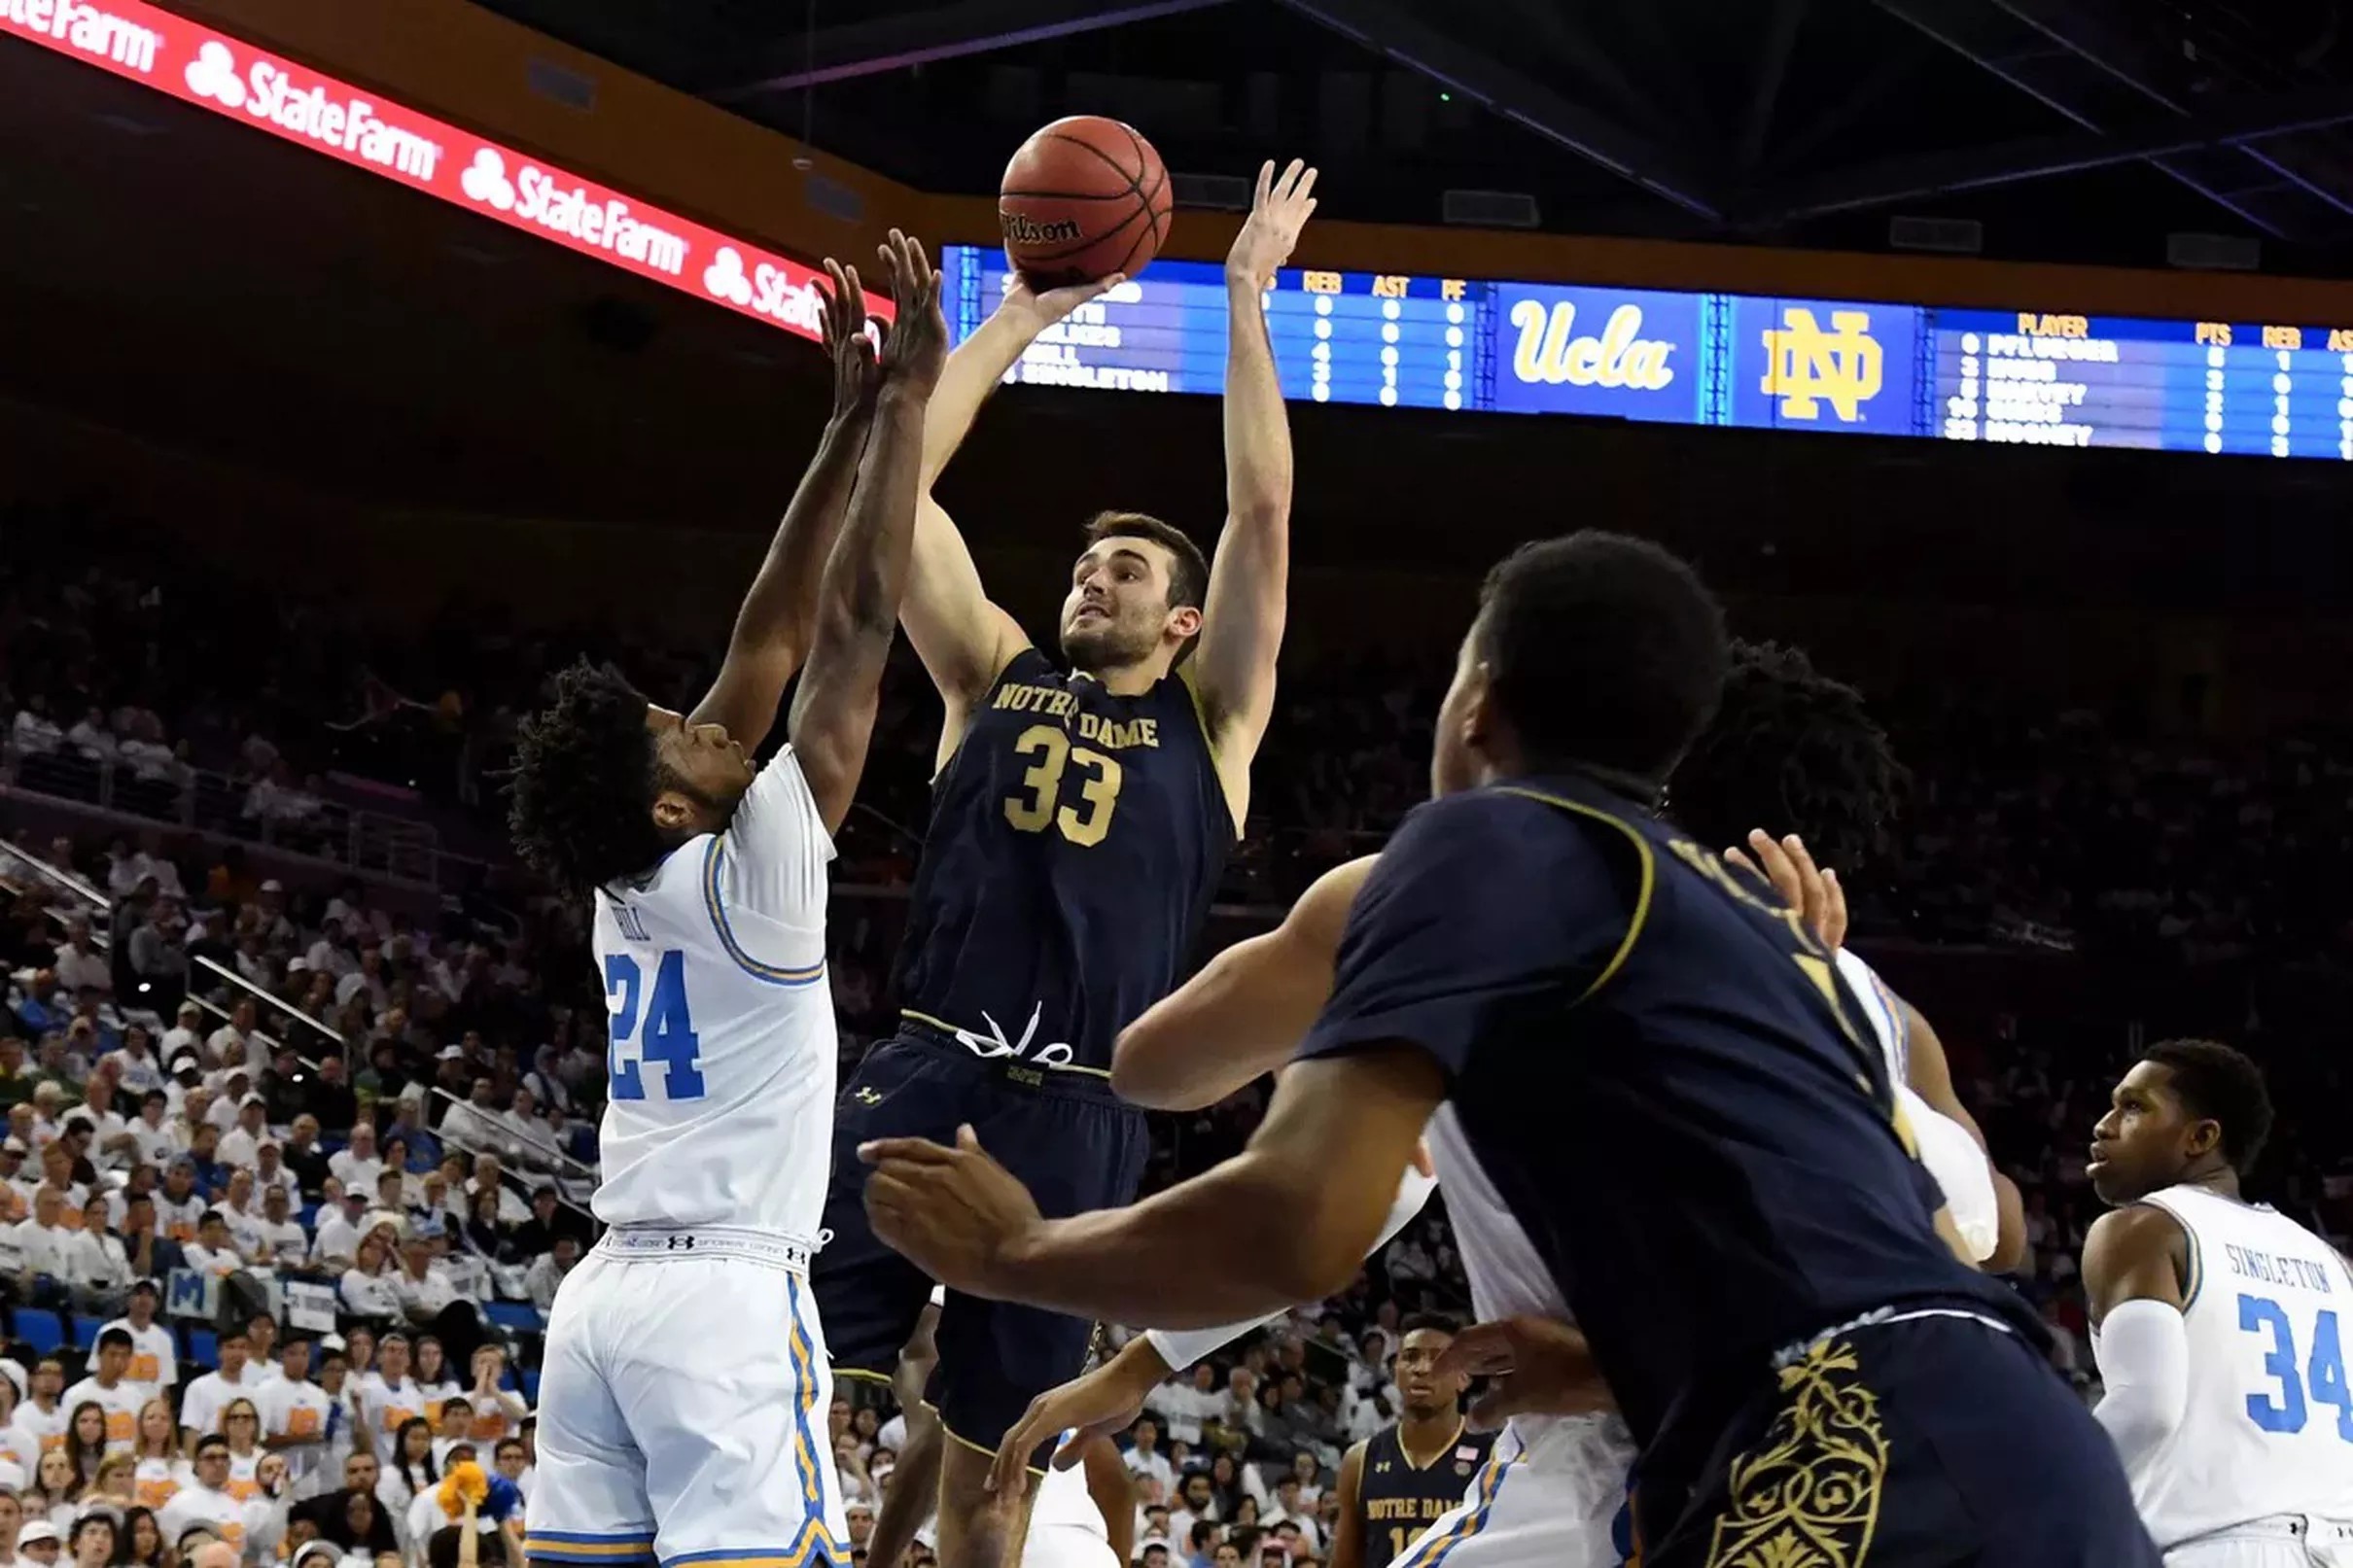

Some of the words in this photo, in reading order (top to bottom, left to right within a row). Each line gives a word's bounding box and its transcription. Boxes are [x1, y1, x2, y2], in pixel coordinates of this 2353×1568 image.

[1304, 271, 1342, 294] REB
[1372, 275, 1410, 297] AST
[1441, 279, 1466, 300] PF
[2018, 312, 2089, 338] PLAYER
[2195, 322, 2231, 346] PTS
[2263, 326, 2301, 350] REB
[1079, 713, 1159, 749] DAME
[1003, 724, 1122, 848] 33
[605, 949, 706, 1100] 24
[2225, 1243, 2332, 1293] SINGLETON
[2237, 1293, 2353, 1444] 34
[1367, 1498, 1417, 1519] NOTRE
[1422, 1498, 1463, 1518] DA
